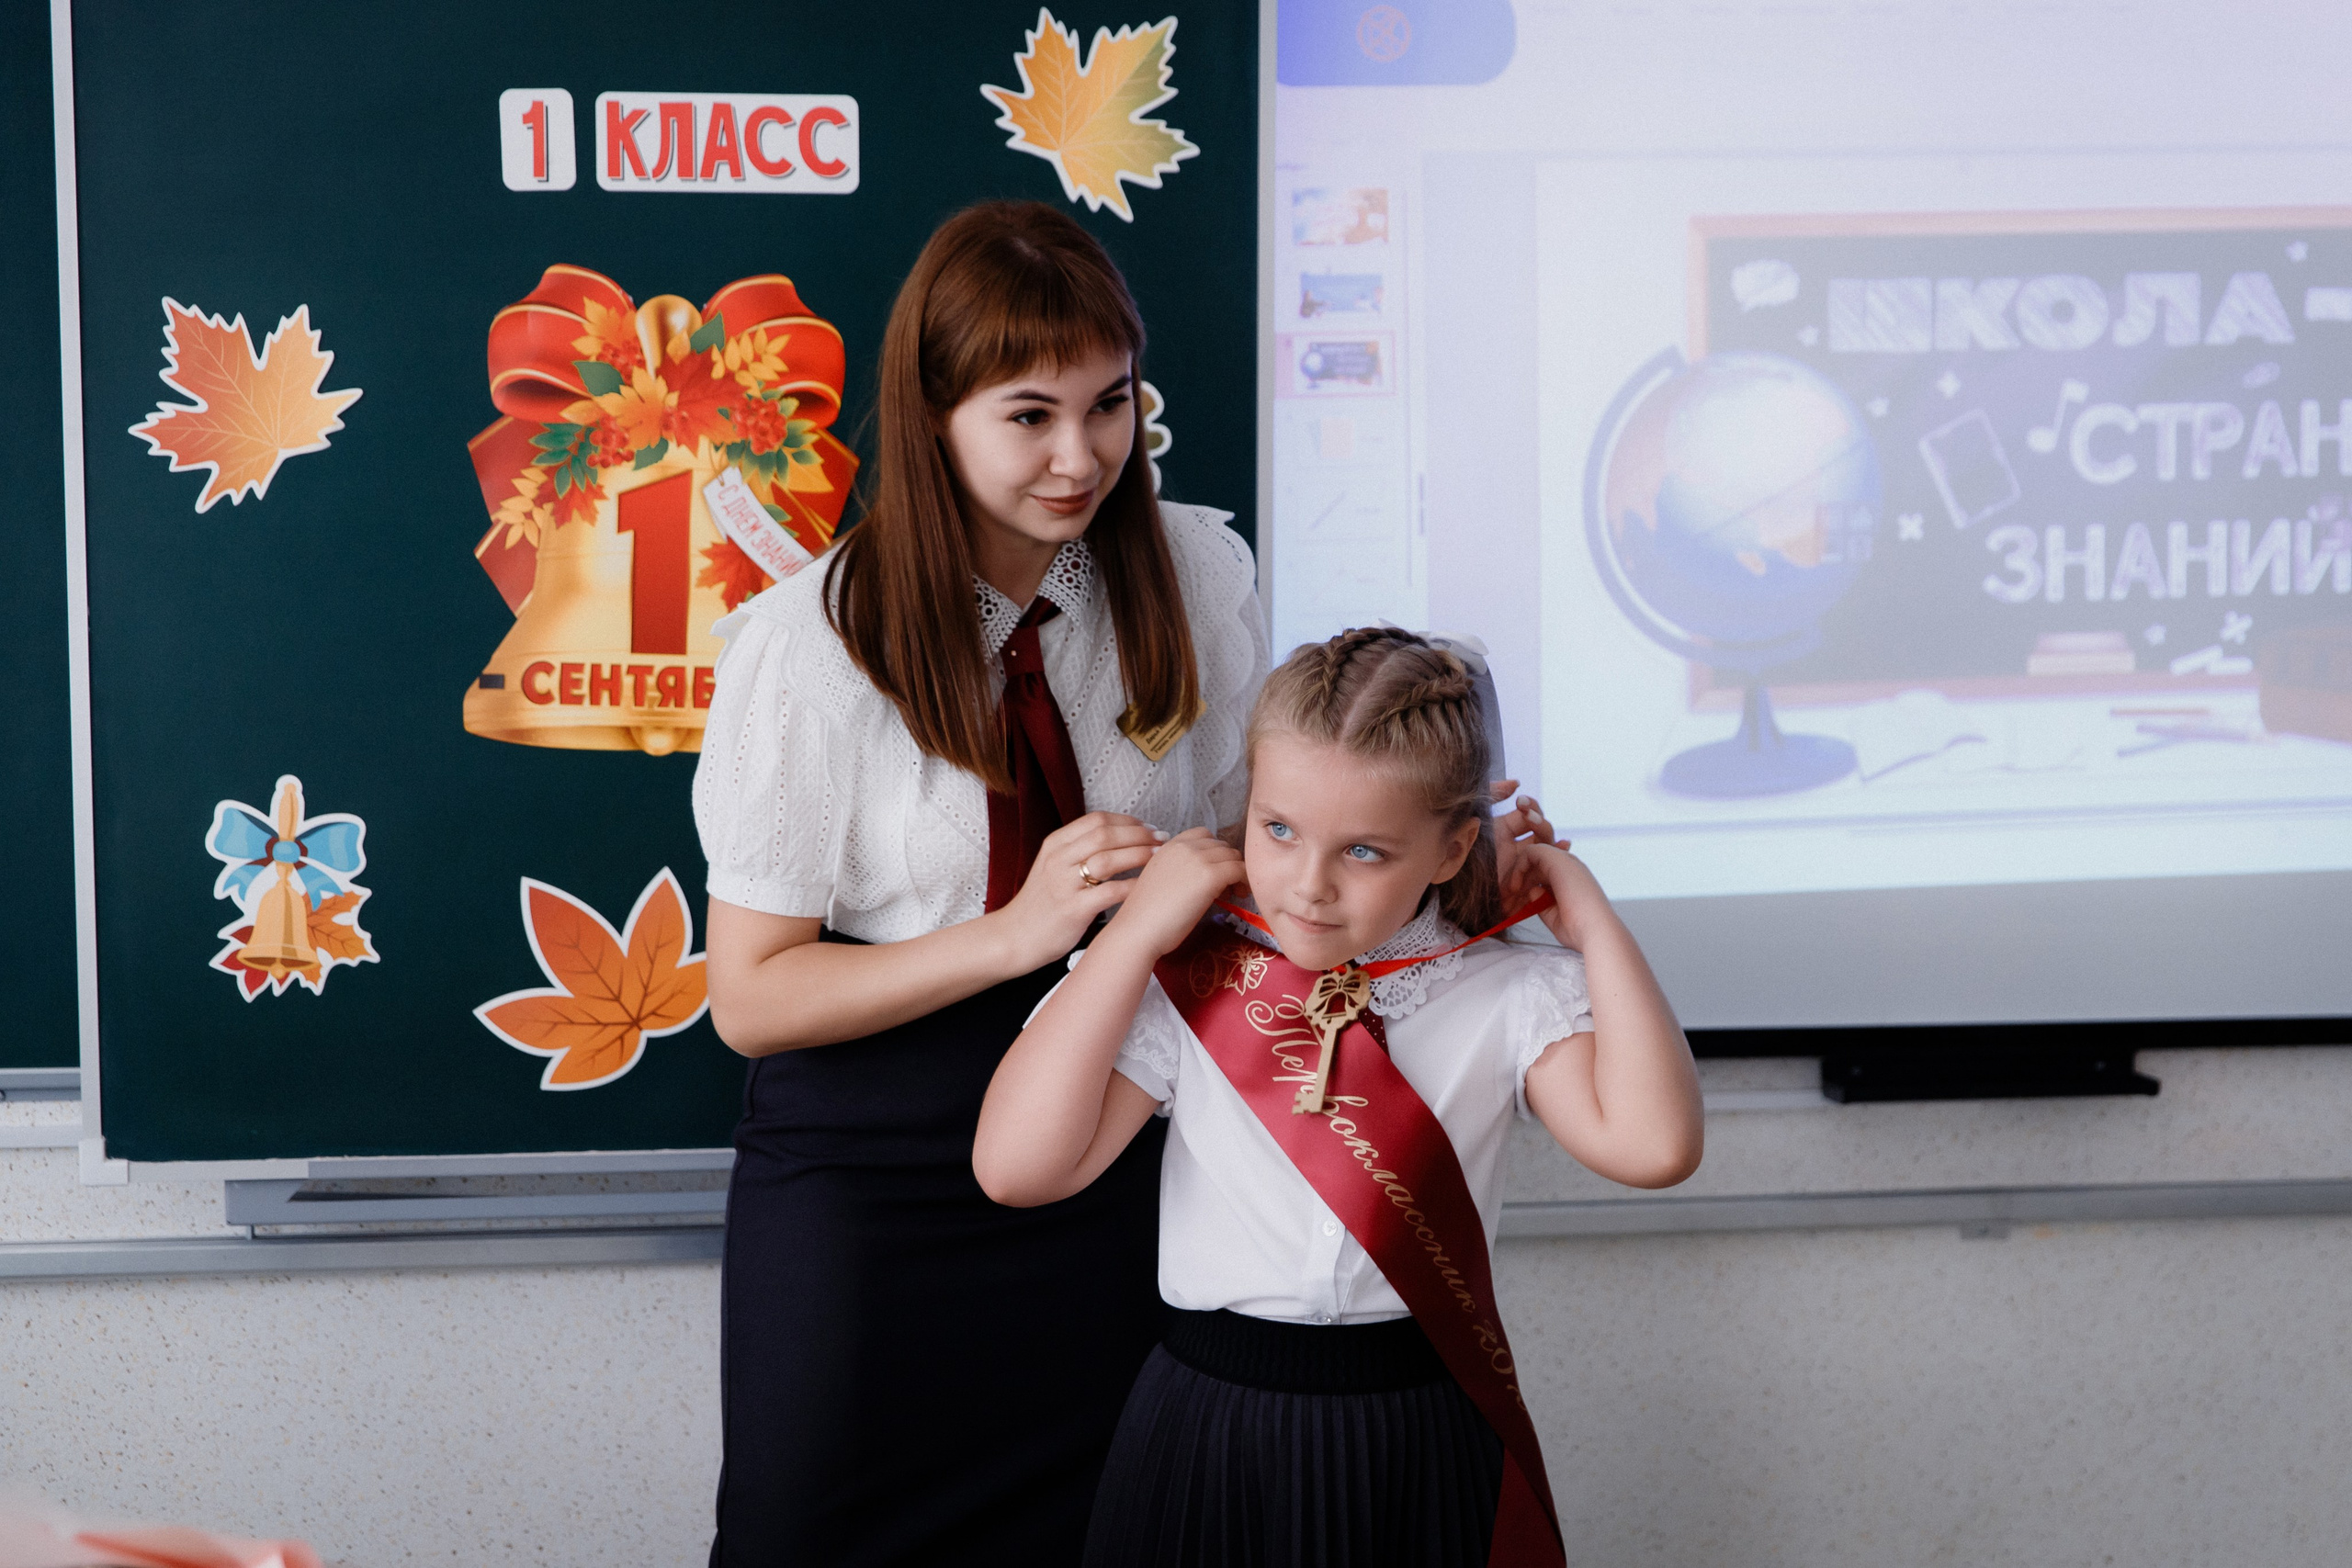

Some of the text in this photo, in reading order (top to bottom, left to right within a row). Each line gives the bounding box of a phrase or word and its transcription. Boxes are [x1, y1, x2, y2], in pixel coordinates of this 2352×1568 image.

[522, 100, 850, 182] 1 КЛАСС
[1827, 273, 2295, 352] ШКОЛА
[2069, 399, 2352, 484] СТРАН
[617, 469, 693, 655] 1
[521, 660, 716, 708] СЕНТЯБ
